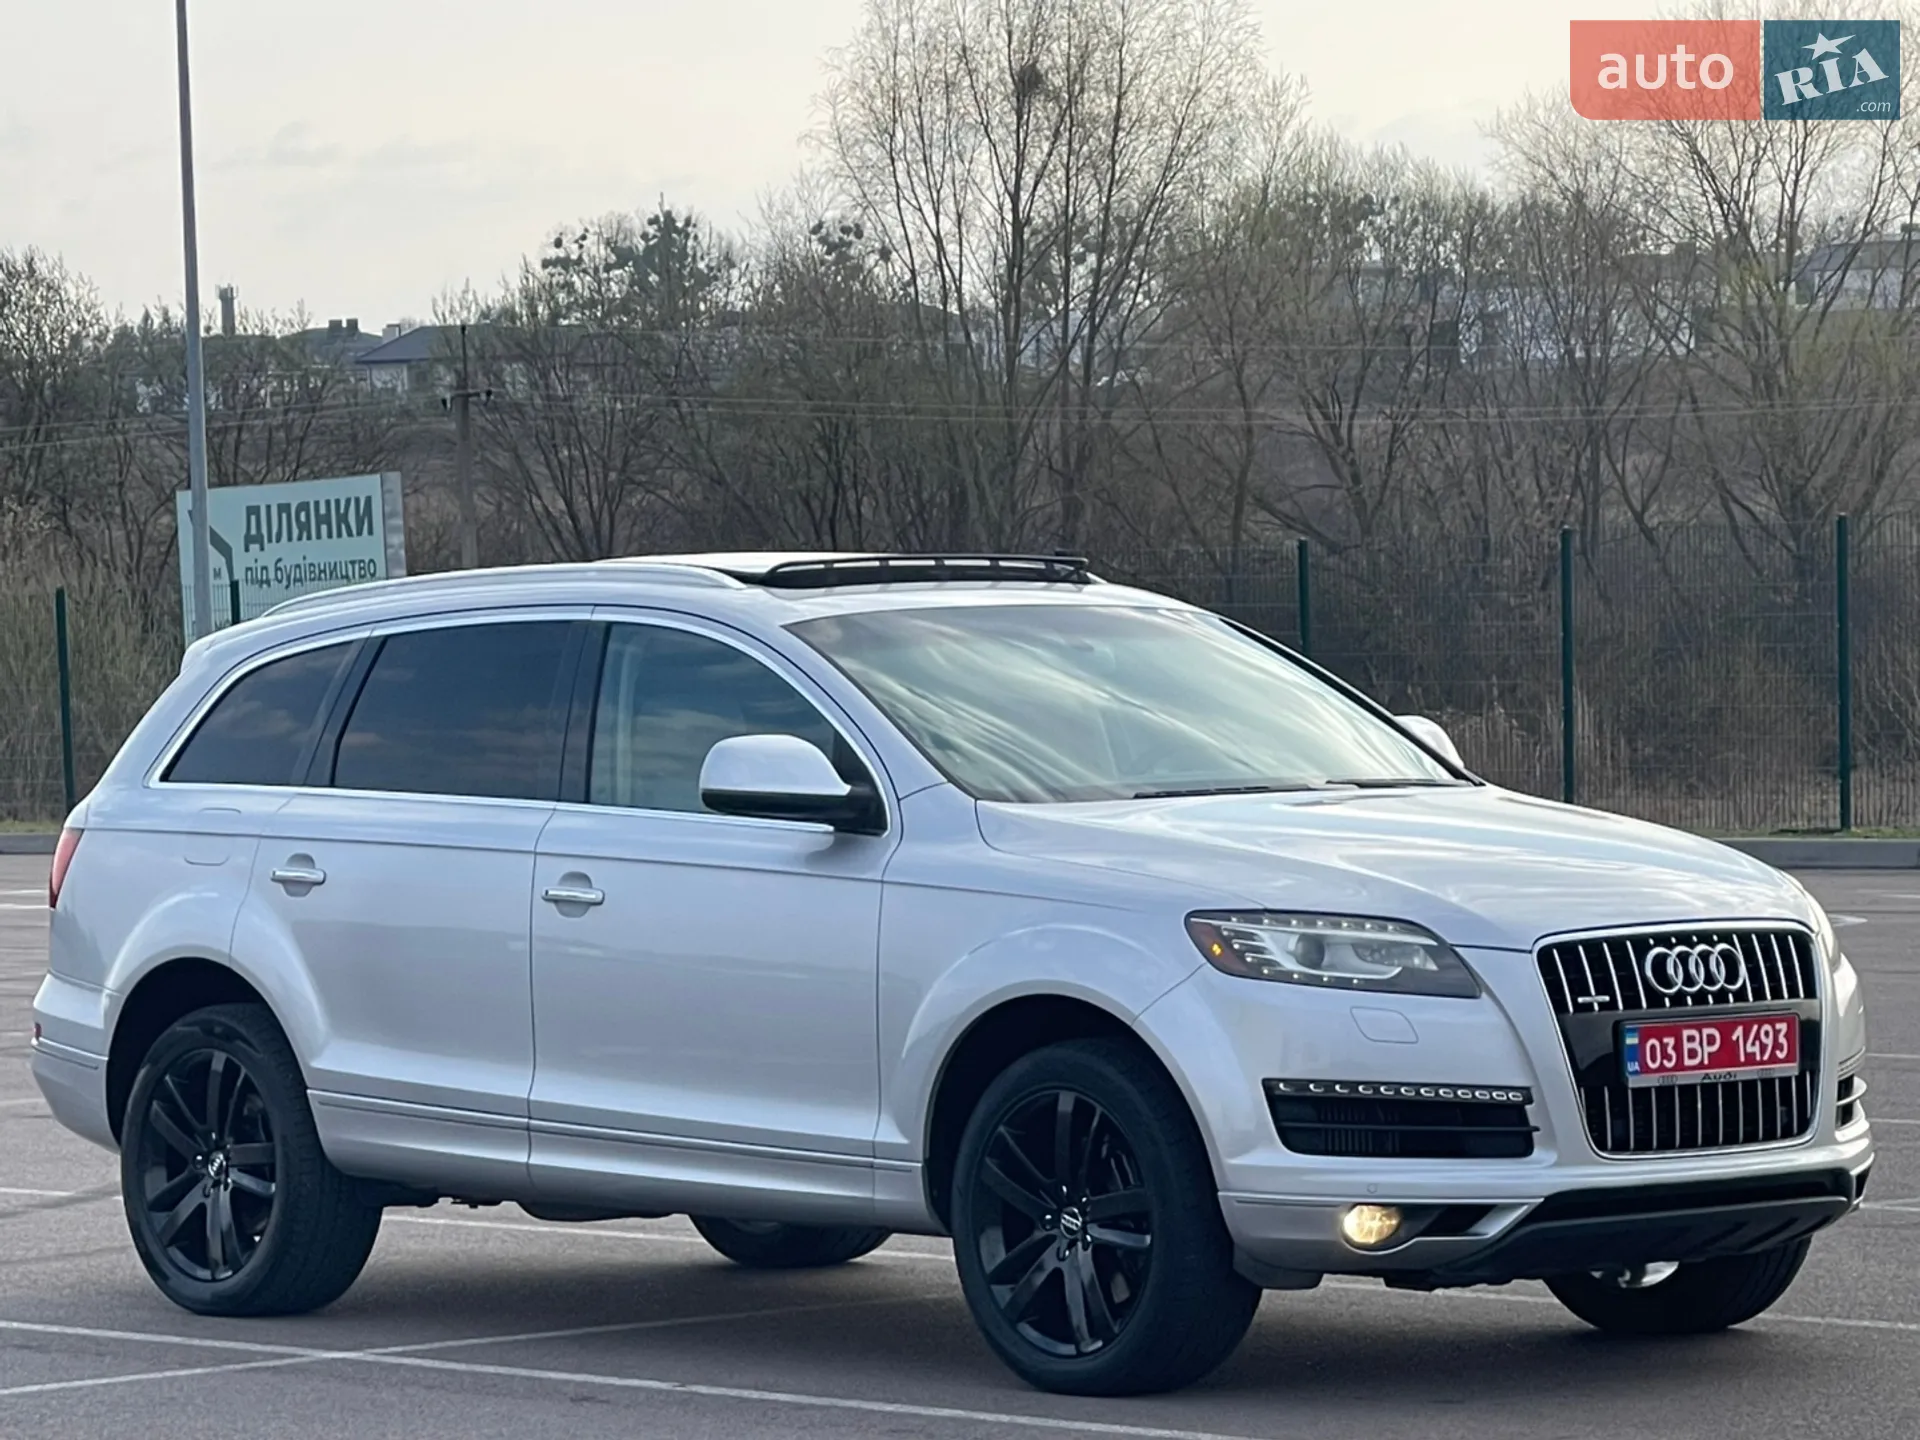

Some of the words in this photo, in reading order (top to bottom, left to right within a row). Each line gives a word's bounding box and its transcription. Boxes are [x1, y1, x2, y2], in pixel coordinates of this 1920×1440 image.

[244, 495, 374, 553] ДІЛЯНКИ
[245, 558, 271, 589] під
[274, 555, 377, 590] будівництво
[1645, 1037, 1677, 1069] 03
[1731, 1022, 1788, 1063] 1493
[1627, 1061, 1640, 1073] UA
[1701, 1072, 1738, 1082] Audi
